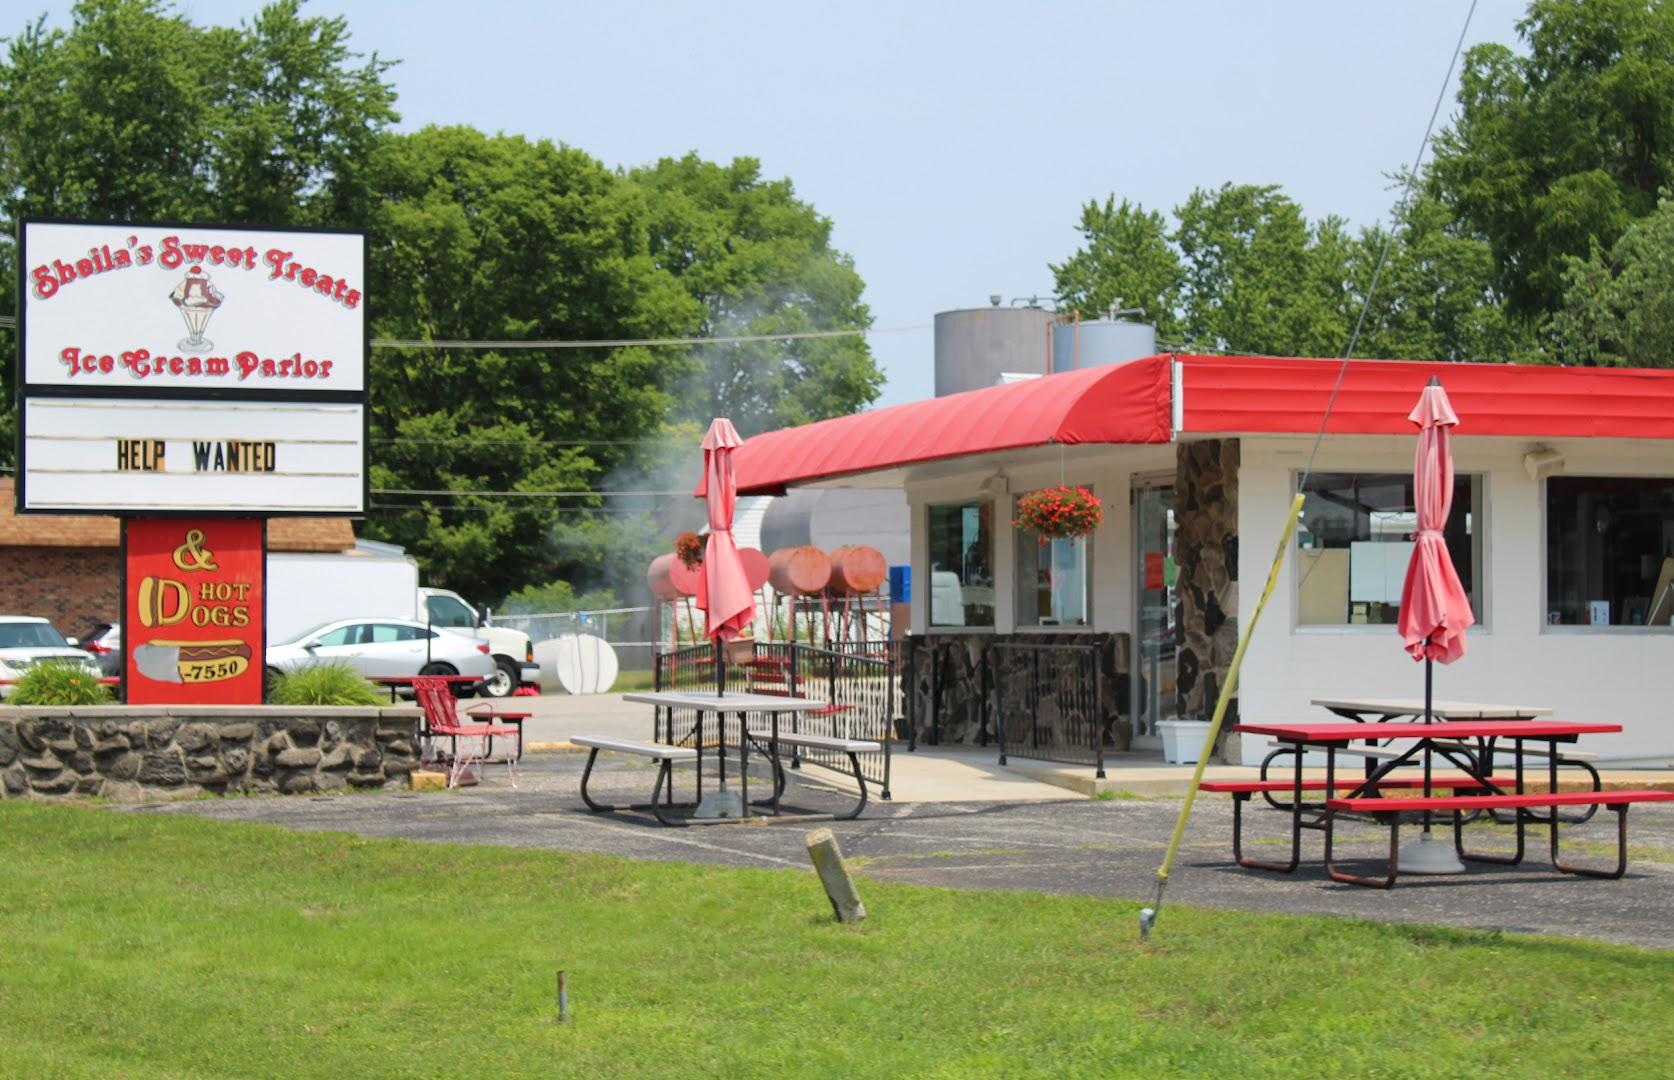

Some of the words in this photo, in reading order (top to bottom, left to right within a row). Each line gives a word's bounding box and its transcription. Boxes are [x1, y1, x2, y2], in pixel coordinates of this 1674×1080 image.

[30, 235, 153, 299] Sheila's
[158, 236, 257, 270] Sweet
[263, 248, 362, 309] Treats
[60, 347, 115, 377] Ice
[120, 348, 230, 379] Cream
[234, 351, 333, 380] Parlor
[117, 440, 166, 471] HELP
[193, 441, 276, 472] WANTED
[172, 529, 219, 571] &
[200, 583, 250, 601] HOT
